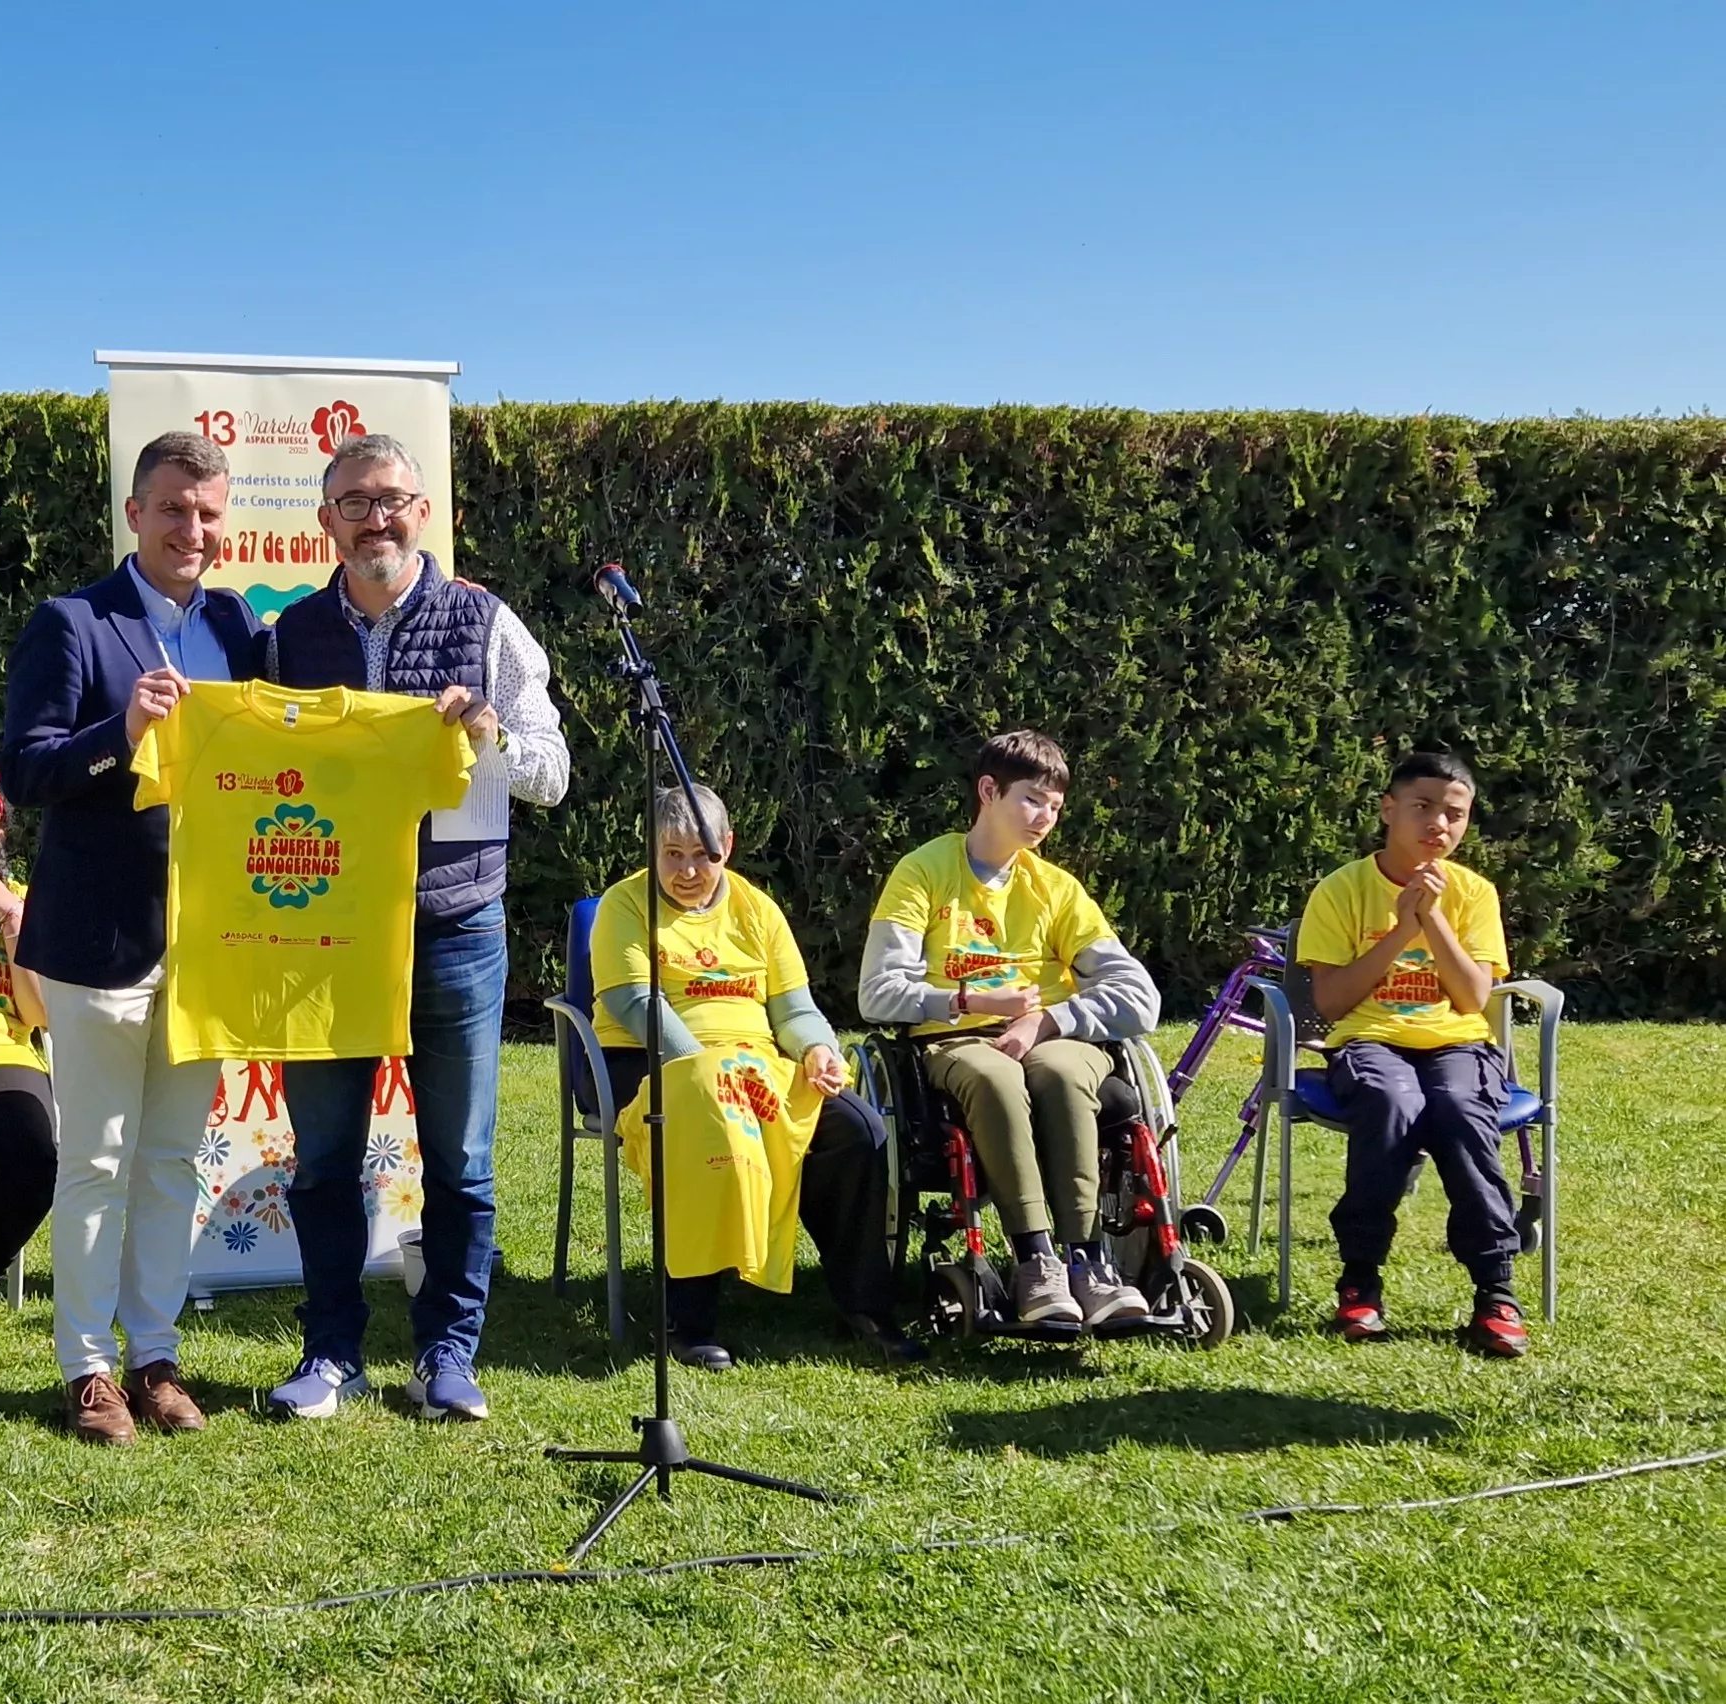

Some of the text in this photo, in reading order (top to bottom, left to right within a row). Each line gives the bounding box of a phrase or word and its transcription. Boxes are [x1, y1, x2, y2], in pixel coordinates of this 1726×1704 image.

[244, 411, 309, 434] Marcha
[245, 436, 309, 445] ASPACE HUESCA
[288, 447, 308, 455] 2025
[229, 474, 290, 486] enderista
[231, 494, 246, 506] de
[251, 495, 315, 509] Congresos
[239, 531, 257, 563] 27
[263, 531, 285, 563] de
[290, 531, 330, 563] abril
[248, 838, 341, 857] LA SUERTE DE
[246, 857, 340, 876] CONOCERNOS
